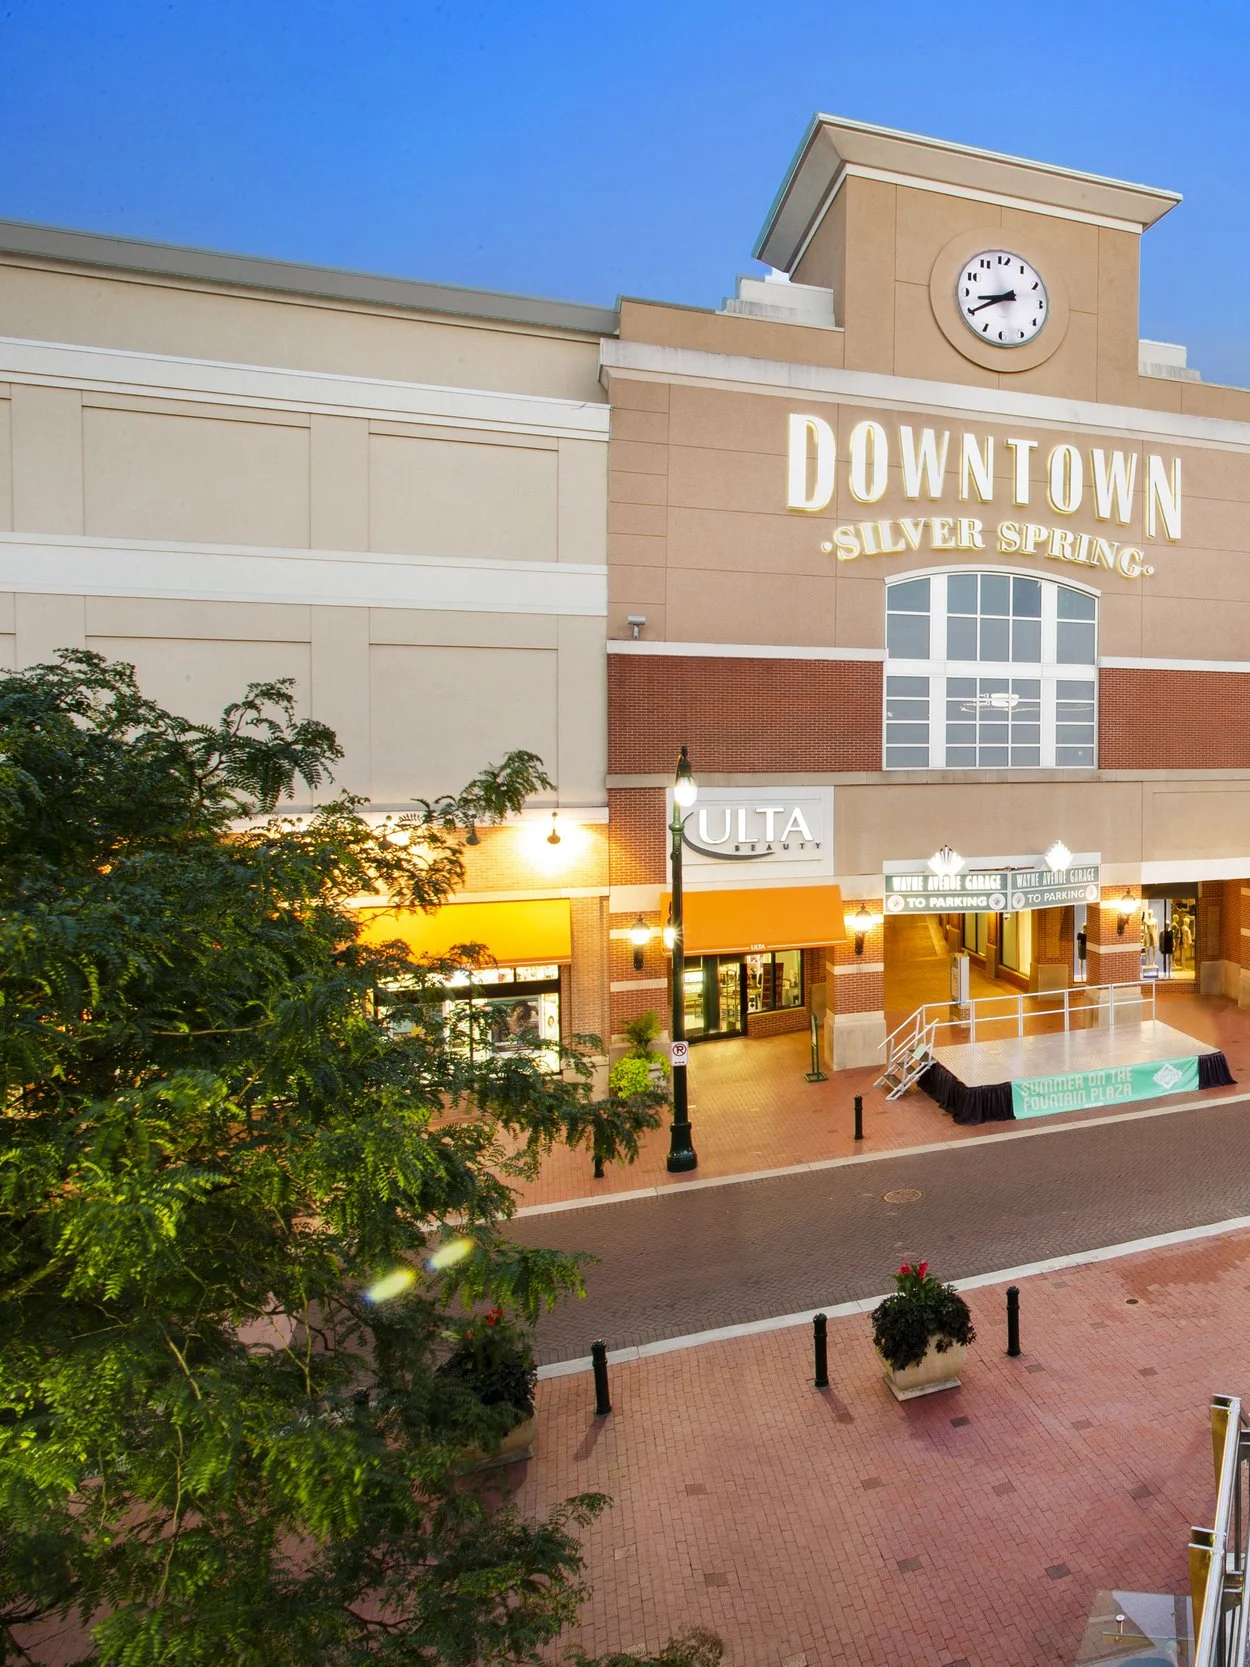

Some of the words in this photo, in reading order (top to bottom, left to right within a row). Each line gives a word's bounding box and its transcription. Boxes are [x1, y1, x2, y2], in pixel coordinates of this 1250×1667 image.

[980, 259, 991, 269] 11
[997, 255, 1011, 266] 12
[967, 272, 982, 282] 10
[1031, 281, 1039, 291] 2
[787, 412, 1182, 541] DOWNTOWN
[833, 517, 986, 560] SILVER
[997, 521, 1145, 579] SPRING
[699, 807, 814, 845] ULTA
[734, 842, 822, 852] BEAUTY
[892, 876, 924, 892] WAYNE
[927, 875, 961, 892] AVENUE
[965, 874, 1001, 890] GARAGE
[1016, 872, 1040, 888] WAYNE
[1042, 870, 1067, 887] AVENUE
[1070, 867, 1095, 883] GARAGE
[906, 897, 926, 908] TO
[929, 896, 987, 908] PARKING
[1026, 893, 1041, 904] TO
[1044, 889, 1085, 902] PARKING
[1021, 1073, 1084, 1097] SUMMER
[1088, 1071, 1106, 1087] ON
[1110, 1067, 1133, 1082] THE
[1023, 1090, 1087, 1112] FOUNTAIN
[1090, 1083, 1133, 1102] PLAZA
